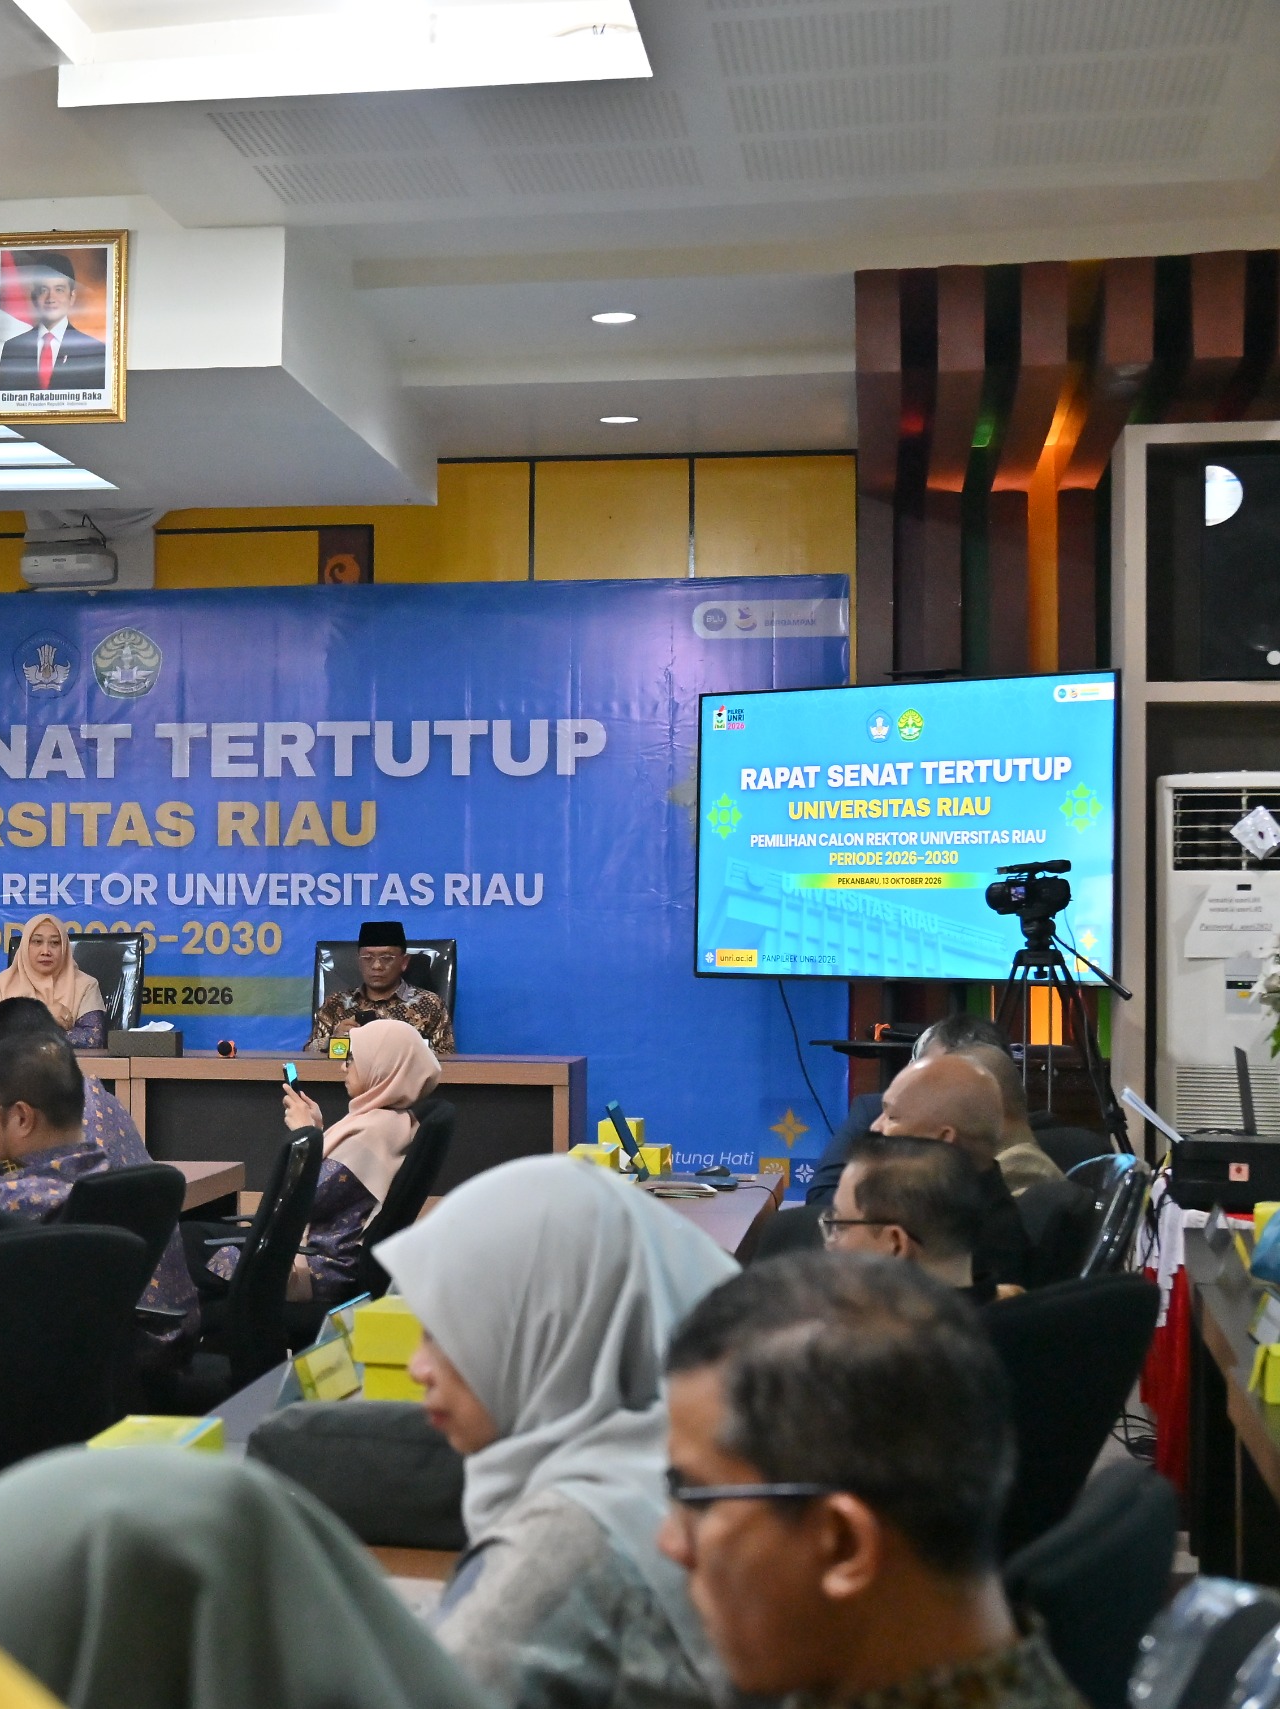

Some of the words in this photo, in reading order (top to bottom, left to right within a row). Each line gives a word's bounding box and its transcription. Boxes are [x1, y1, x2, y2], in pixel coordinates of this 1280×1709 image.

[2, 393, 28, 401] Gibran
[30, 392, 80, 401] Rakabuming
[82, 392, 102, 400] Raka
[728, 722, 745, 730] 2026
[154, 719, 608, 778] TERTUTUP
[740, 766, 821, 790] RAPAT
[827, 762, 914, 788] SENAT
[920, 756, 1072, 785] TERTUTUP
[789, 798, 931, 820] UNIVERSITAS
[937, 796, 991, 817] RIAU
[217, 801, 377, 847] RIAU
[750, 833, 817, 848] PEMILIHAN
[819, 833, 864, 847] CALON
[866, 832, 918, 846] REKTOR
[921, 830, 1010, 845] UNIVERSITAS
[1012, 830, 1047, 844] RIAU
[829, 852, 883, 866] PERIODE
[885, 850, 959, 865] 2026-2030
[3, 873, 158, 906] REKTOR
[170, 873, 435, 906] UNIVERSITAS
[444, 872, 544, 906] RIAU
[838, 878, 881, 886] PEKANBARU,
[65, 921, 282, 956] 6-2030
[720, 954, 753, 962] unri.ac.id
[762, 955, 798, 963] PANPILREK
[800, 955, 817, 963] UNRI
[818, 956, 837, 964] 2026
[182, 987, 234, 1005] 2026
[672, 1152, 715, 1169] tung
[720, 1152, 755, 1166] Hati
